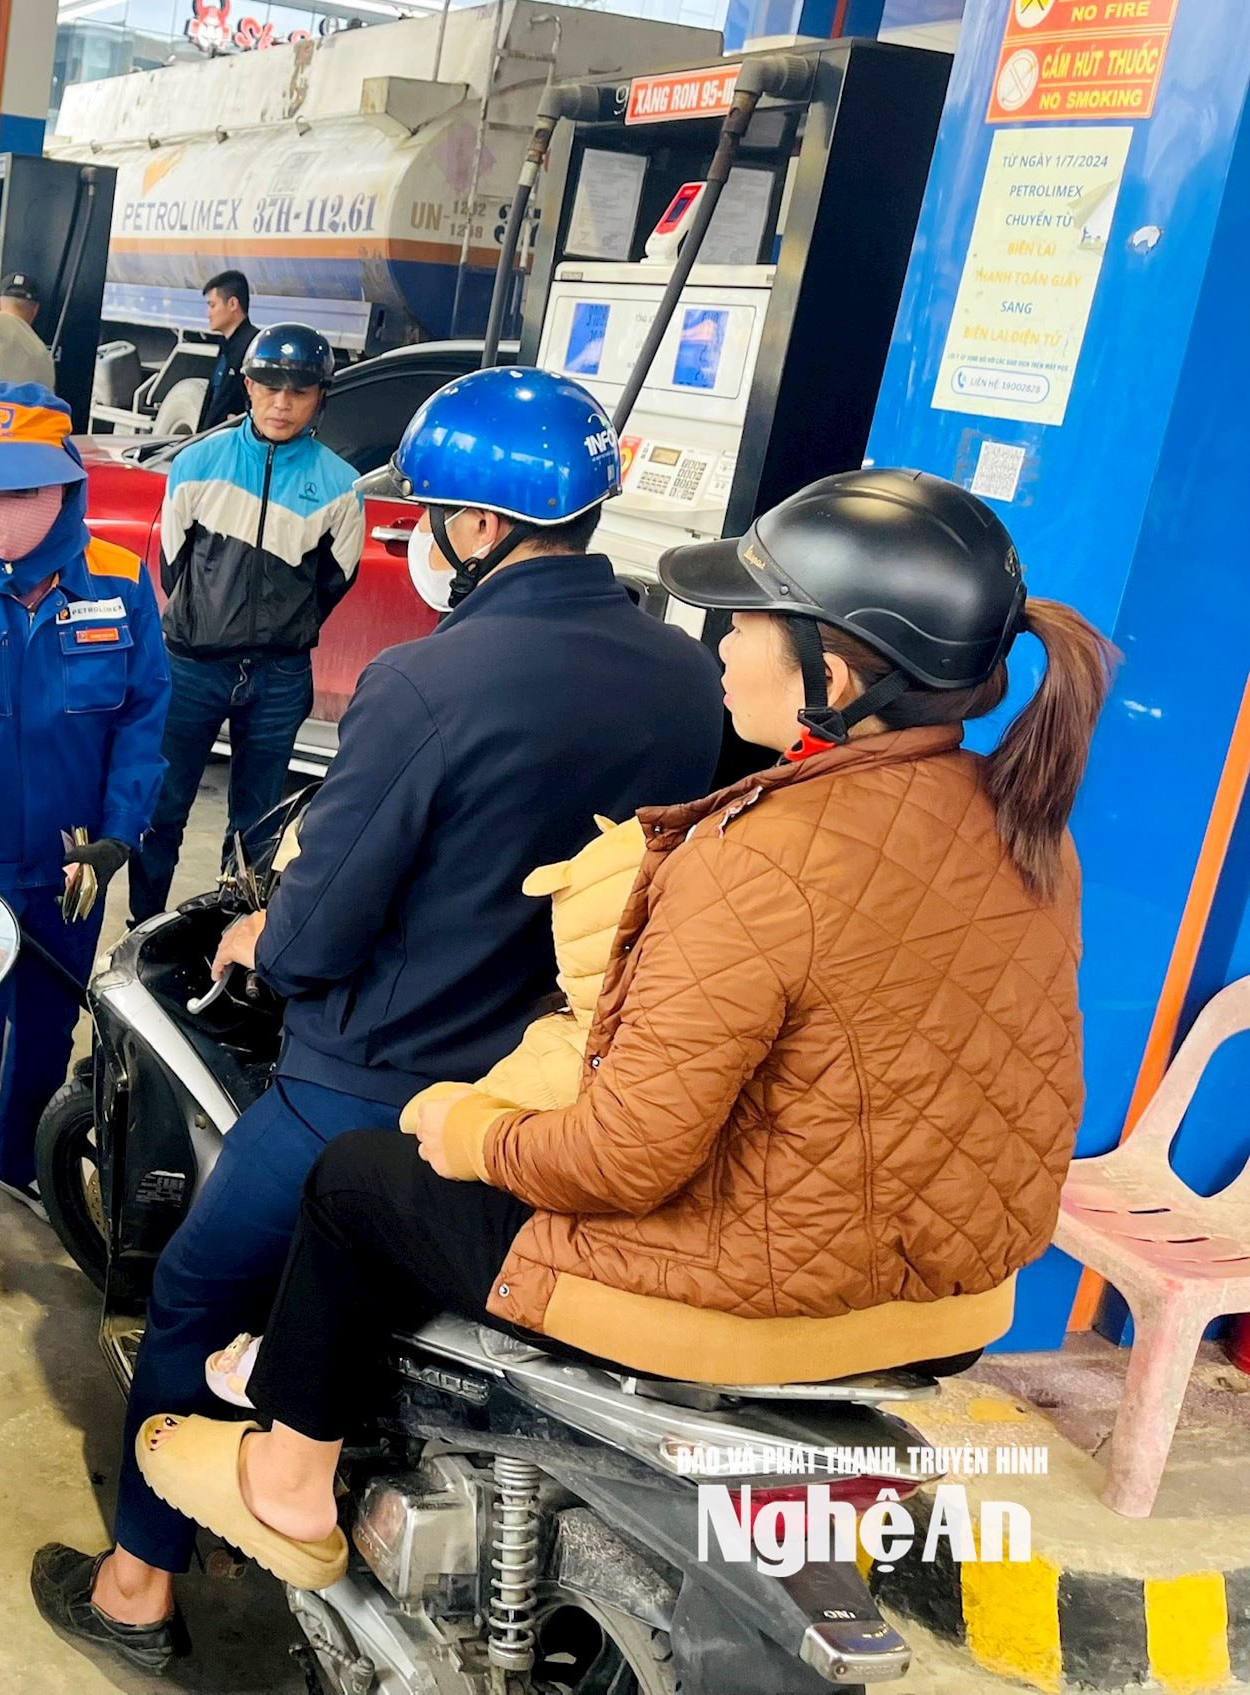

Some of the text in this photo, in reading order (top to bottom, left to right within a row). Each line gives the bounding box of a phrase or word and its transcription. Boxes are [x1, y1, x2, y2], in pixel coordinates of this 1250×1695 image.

[1071, 1, 1150, 22] NO FIRE
[1042, 41, 1158, 79] CẤM HÚT THUỐC
[635, 80, 670, 115] XĂNG
[671, 82, 699, 109] RON
[1039, 89, 1143, 110] NO SMOKING
[1003, 153, 1109, 168] TỪ NGÀY 1/7/2024
[1009, 185, 1084, 198] PETROLIMEX
[122, 199, 242, 231] PETROLIMEX
[253, 192, 379, 234] 37H-112.61
[1056, 212, 1075, 228] TỪ
[1037, 243, 1056, 258] LAI
[1015, 270, 1048, 286] TOÁN
[1000, 301, 1033, 314] SANG
[991, 328, 1009, 342] LAI
[72, 605, 123, 616] PETROLIMEX
